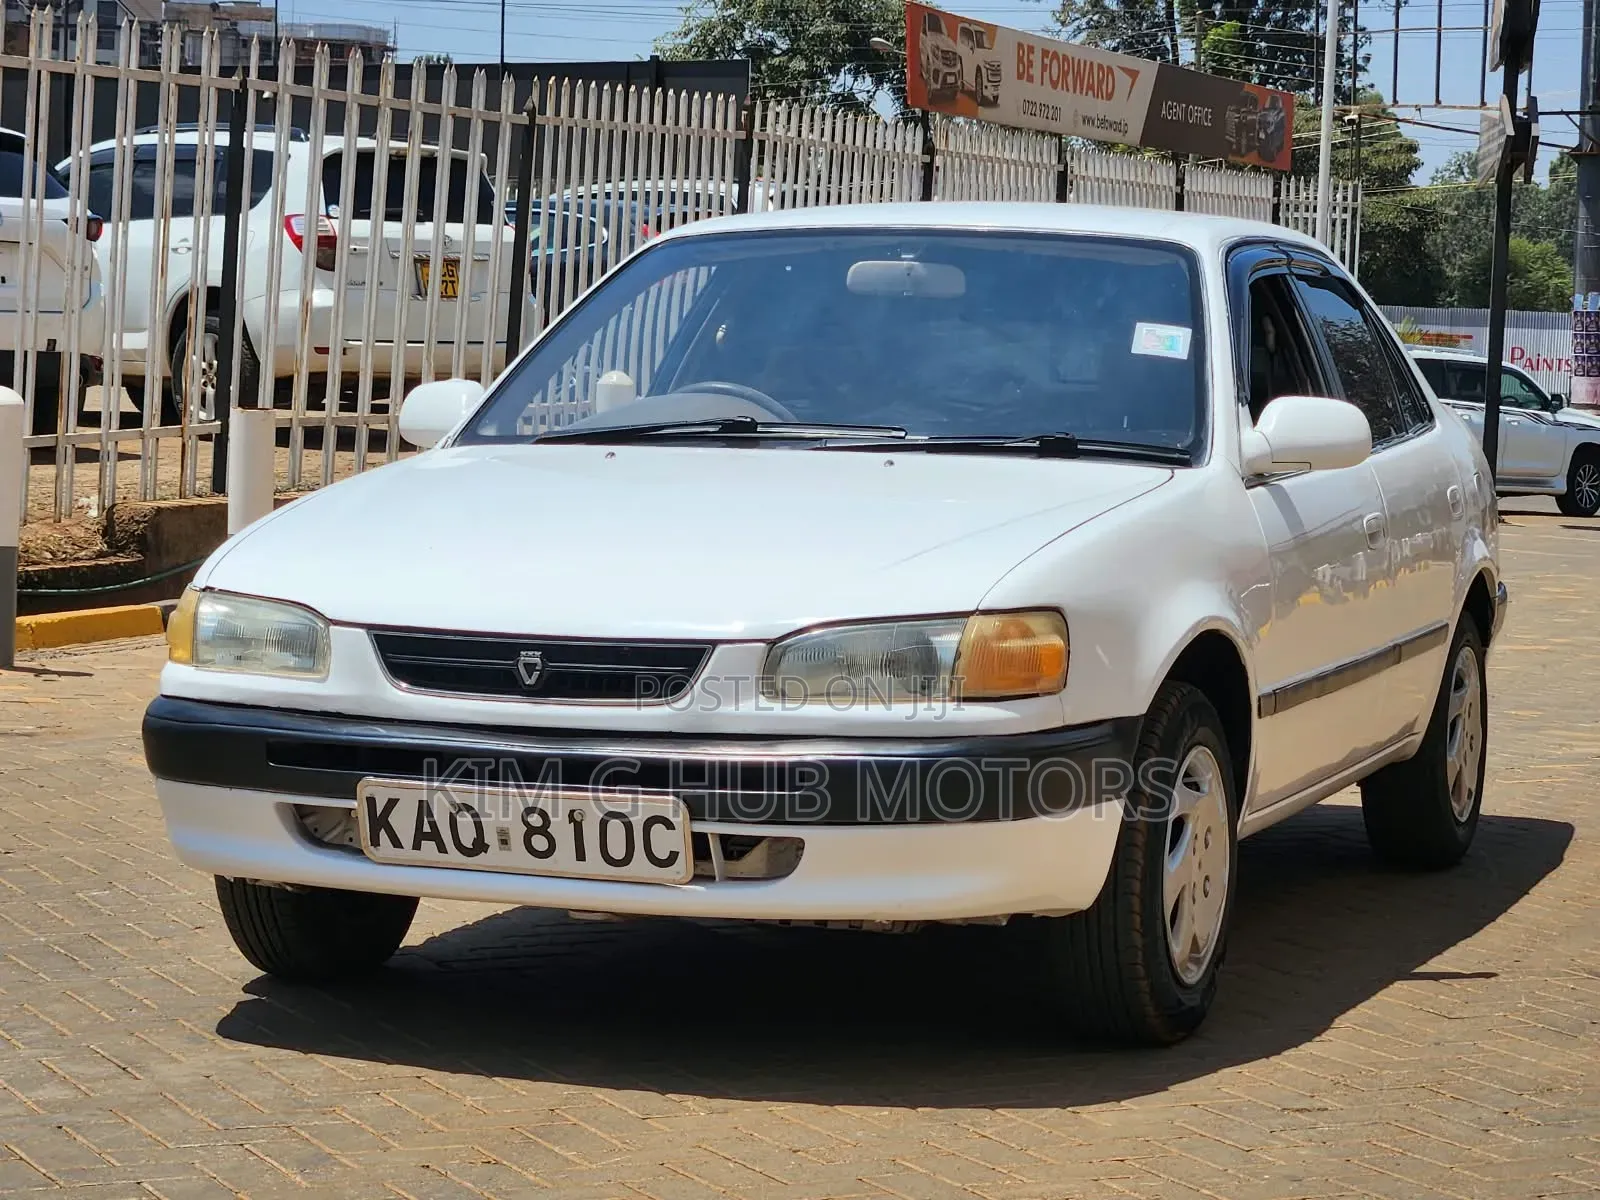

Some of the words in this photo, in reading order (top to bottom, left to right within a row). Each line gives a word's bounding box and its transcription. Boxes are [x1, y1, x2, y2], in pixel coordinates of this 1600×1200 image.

[1016, 42, 1035, 84] BE
[1041, 48, 1116, 101] FORWARD
[1022, 99, 1038, 117] 0722
[1039, 103, 1050, 120] 972
[1051, 106, 1062, 123] 201
[1161, 100, 1186, 122] AGENT
[1188, 105, 1212, 127] OFFICE
[366, 796, 490, 858] KAQ
[521, 806, 680, 869] 810C
